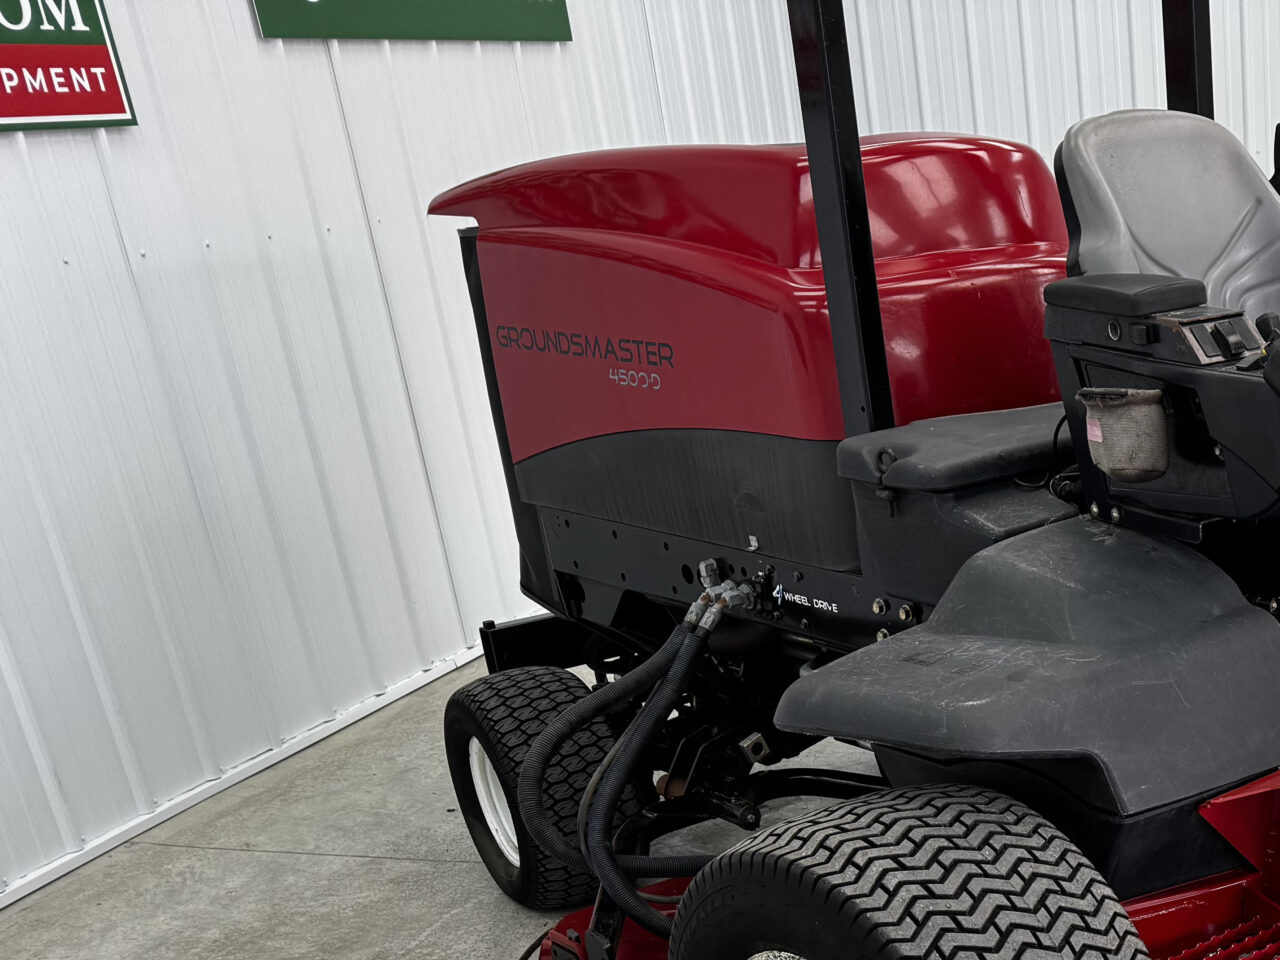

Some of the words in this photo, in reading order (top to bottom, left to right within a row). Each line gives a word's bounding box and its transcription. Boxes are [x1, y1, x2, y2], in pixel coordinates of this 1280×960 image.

[496, 325, 674, 368] GROUNDSMASTER
[772, 583, 783, 605] 4
[783, 591, 811, 607] WHEEL
[812, 598, 838, 613] DRIVE
